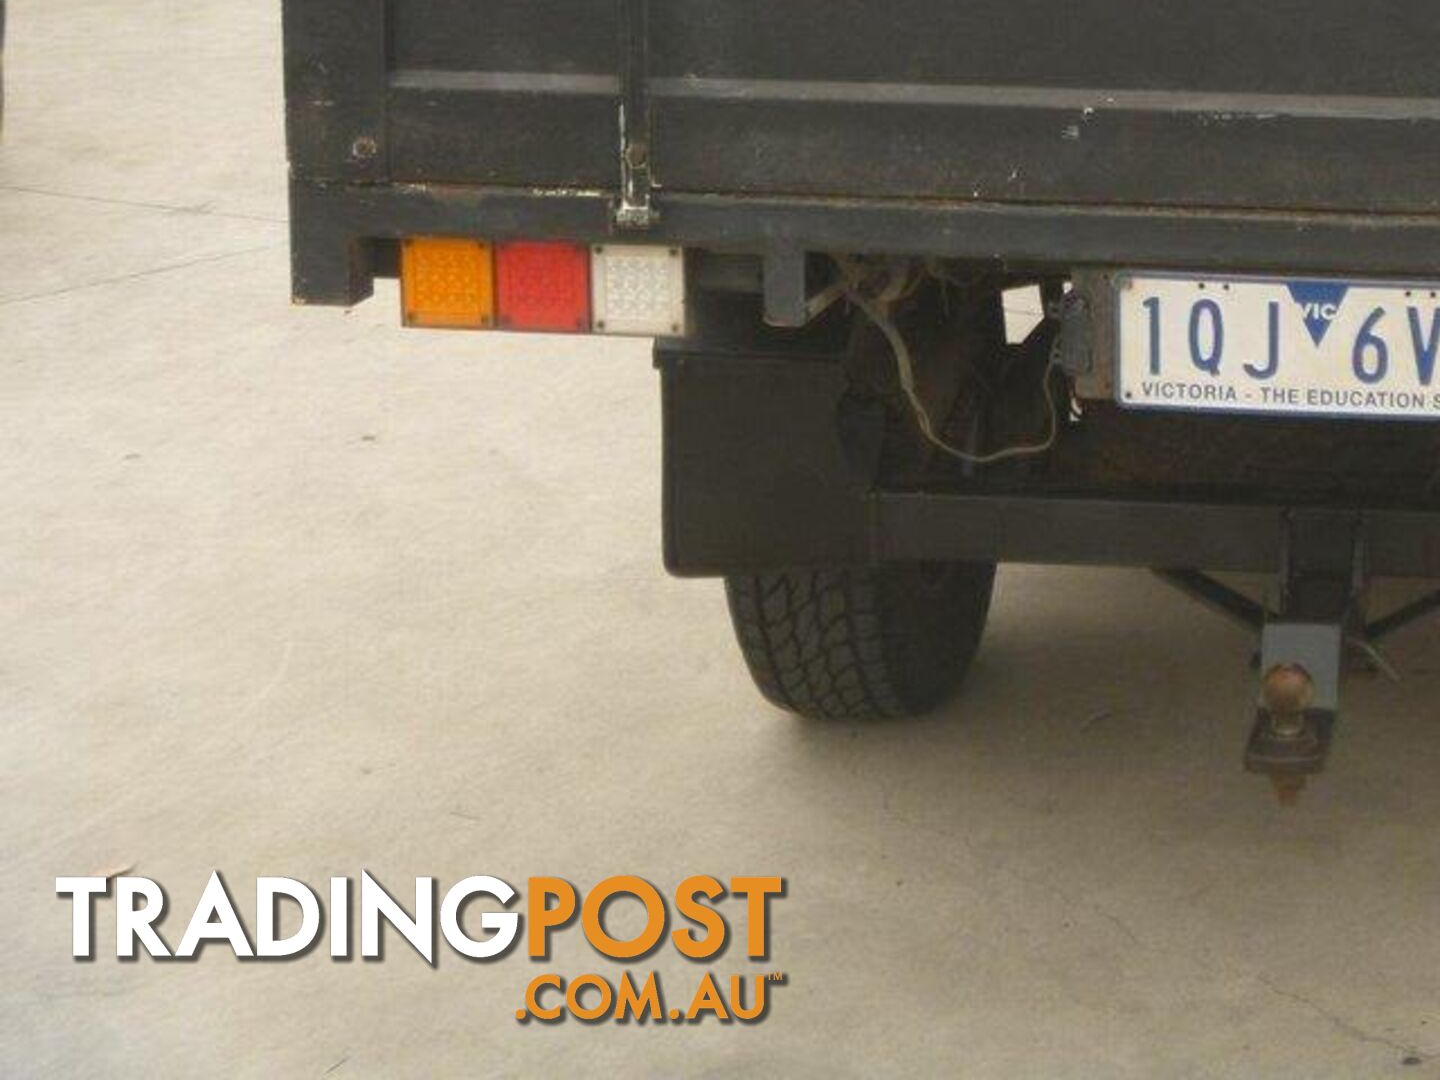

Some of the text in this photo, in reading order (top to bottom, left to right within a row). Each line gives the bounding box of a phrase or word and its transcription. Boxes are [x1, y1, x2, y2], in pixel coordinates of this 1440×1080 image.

[1142, 296, 1280, 380] 1QJ
[1141, 381, 1237, 402] VICTORIA
[1261, 386, 1299, 405] THE
[1306, 388, 1426, 409] EDUCATION
